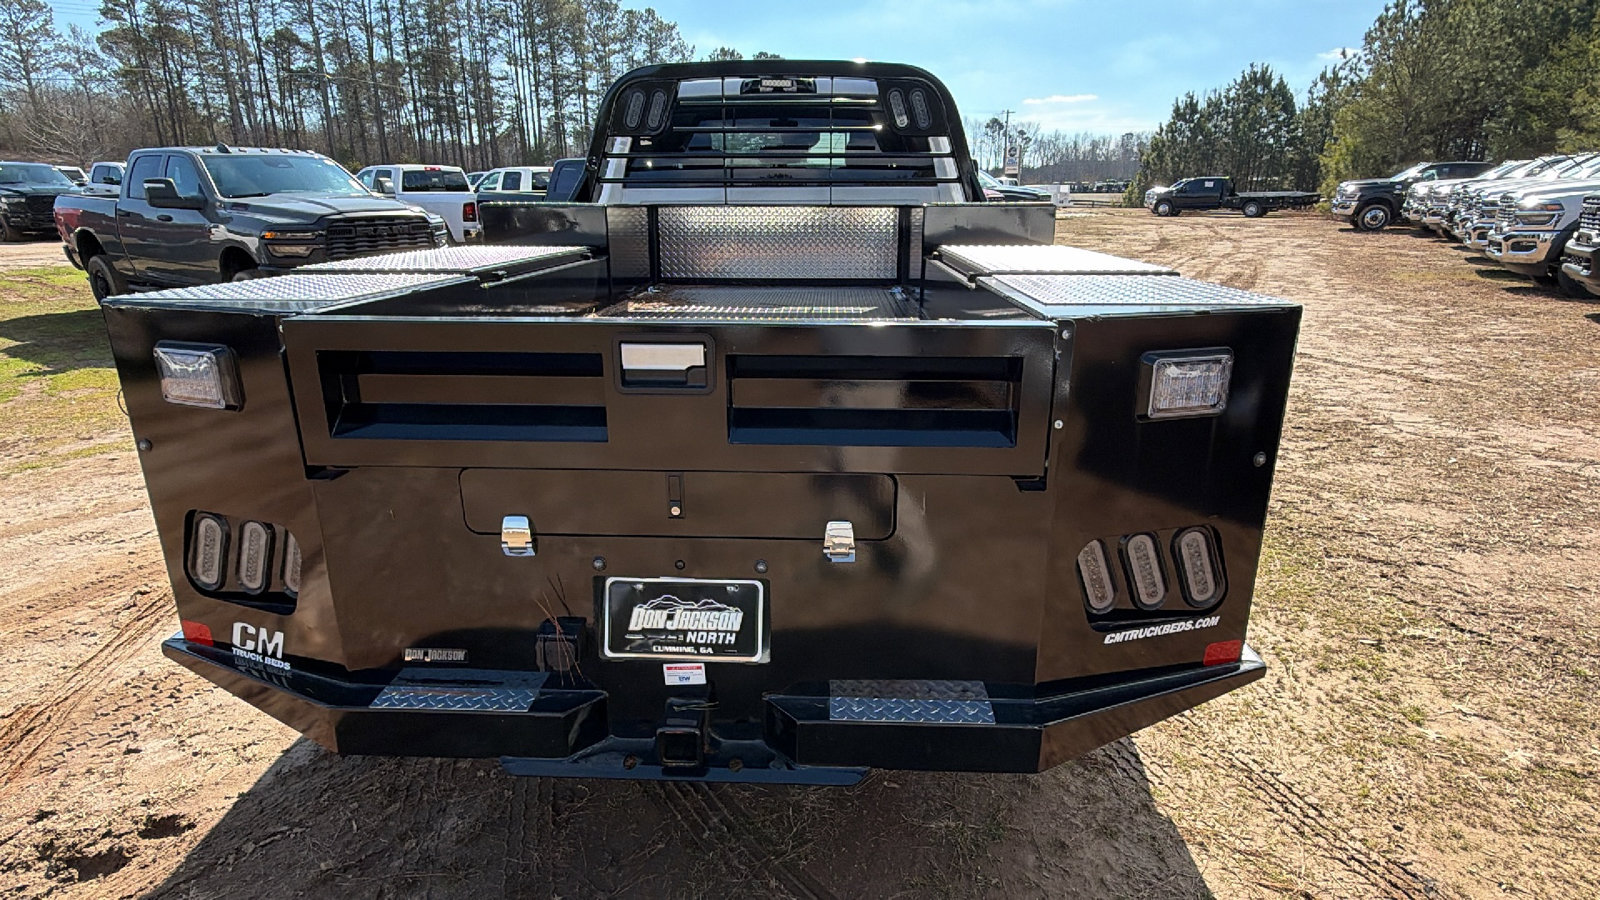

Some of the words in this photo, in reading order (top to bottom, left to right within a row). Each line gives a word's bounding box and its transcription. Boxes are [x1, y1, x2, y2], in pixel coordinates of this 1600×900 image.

[628, 608, 666, 631] DON
[666, 609, 744, 631] JACKSON
[1103, 616, 1220, 645] CMTRUCKBEDS.COM
[232, 622, 284, 659] CM
[686, 631, 736, 644] NORTH
[231, 647, 263, 662] TRUCK
[264, 656, 291, 670] BEDS
[404, 648, 425, 661] DON
[425, 648, 465, 661] JACKSON
[652, 645, 697, 654] CUMMING,
[700, 646, 713, 654] GA
